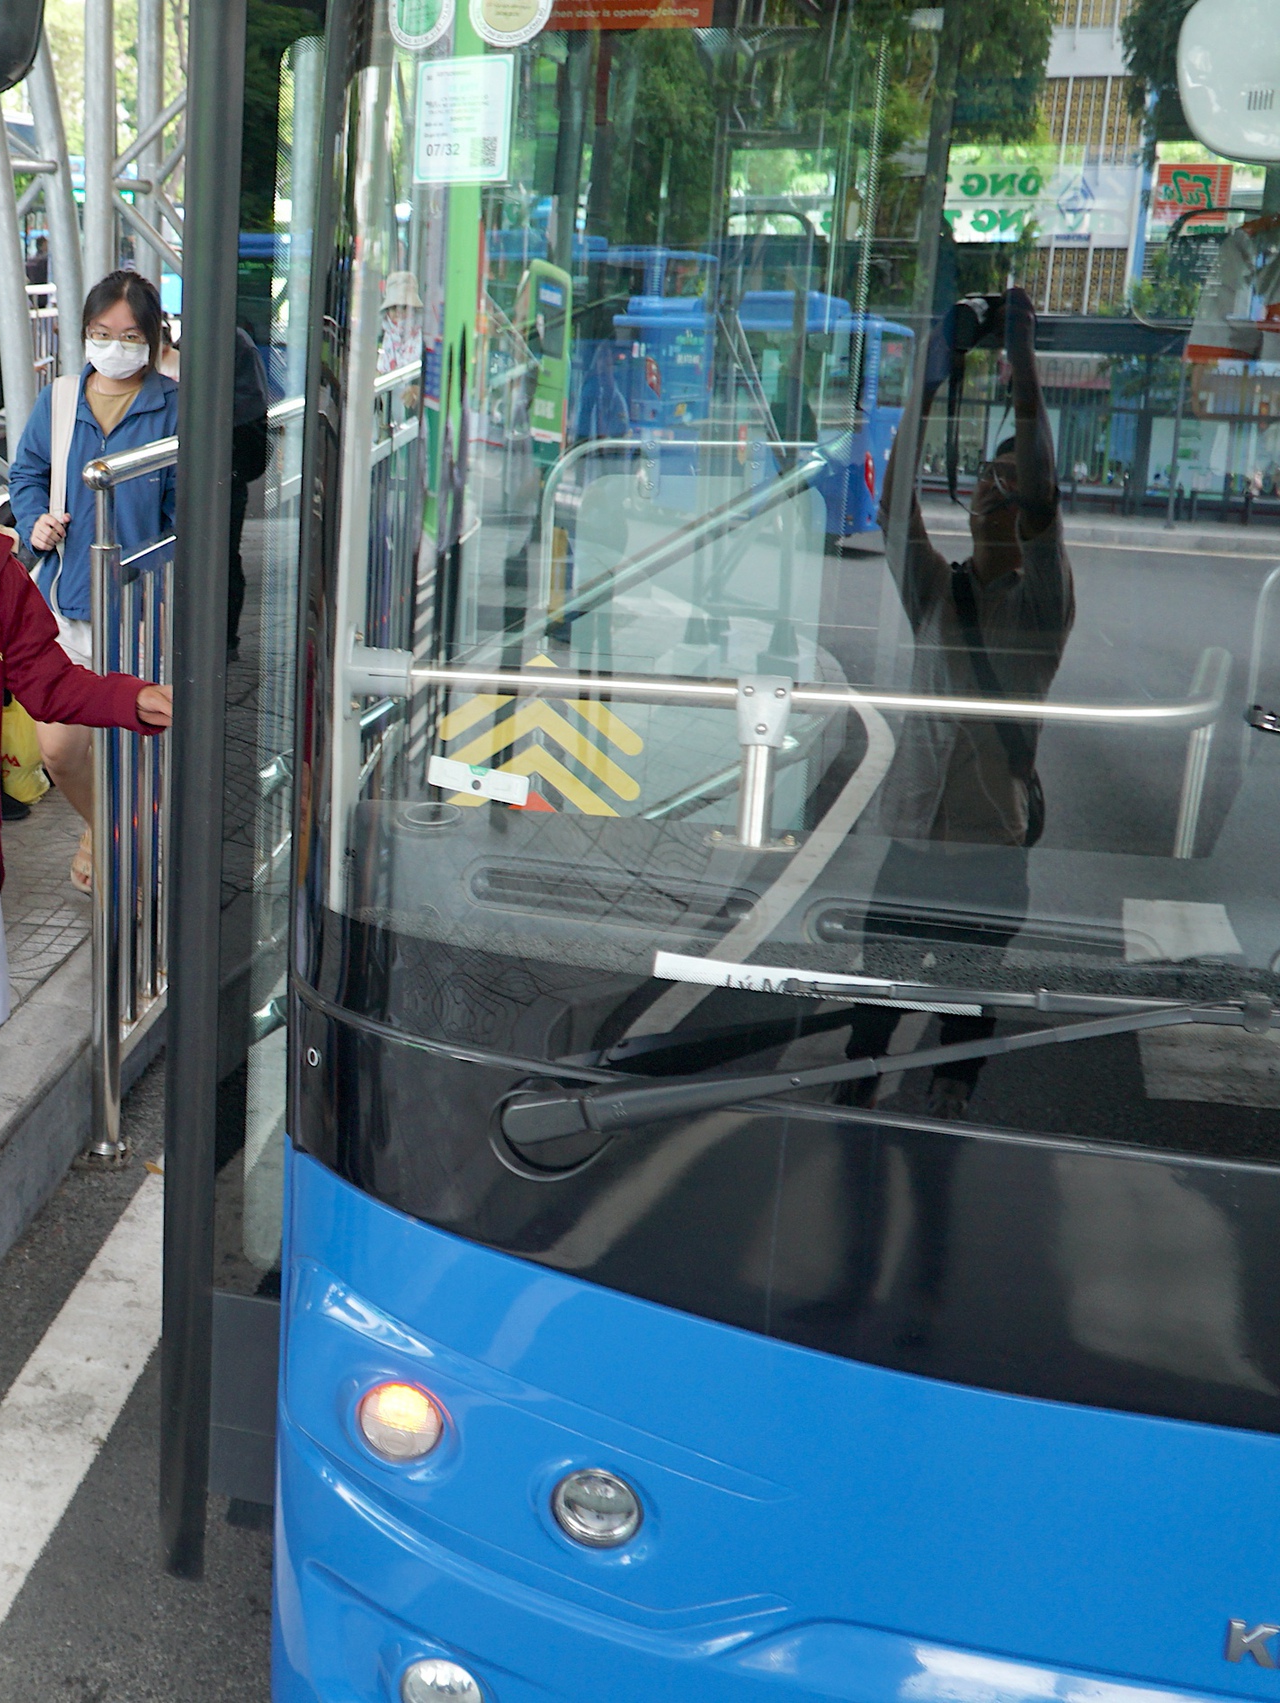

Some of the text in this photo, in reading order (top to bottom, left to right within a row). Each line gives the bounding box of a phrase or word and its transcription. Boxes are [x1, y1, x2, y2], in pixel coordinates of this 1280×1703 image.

[613, 7, 699, 19] opening/closing
[426, 142, 461, 157] 07/32
[1224, 1618, 1280, 1669] K
